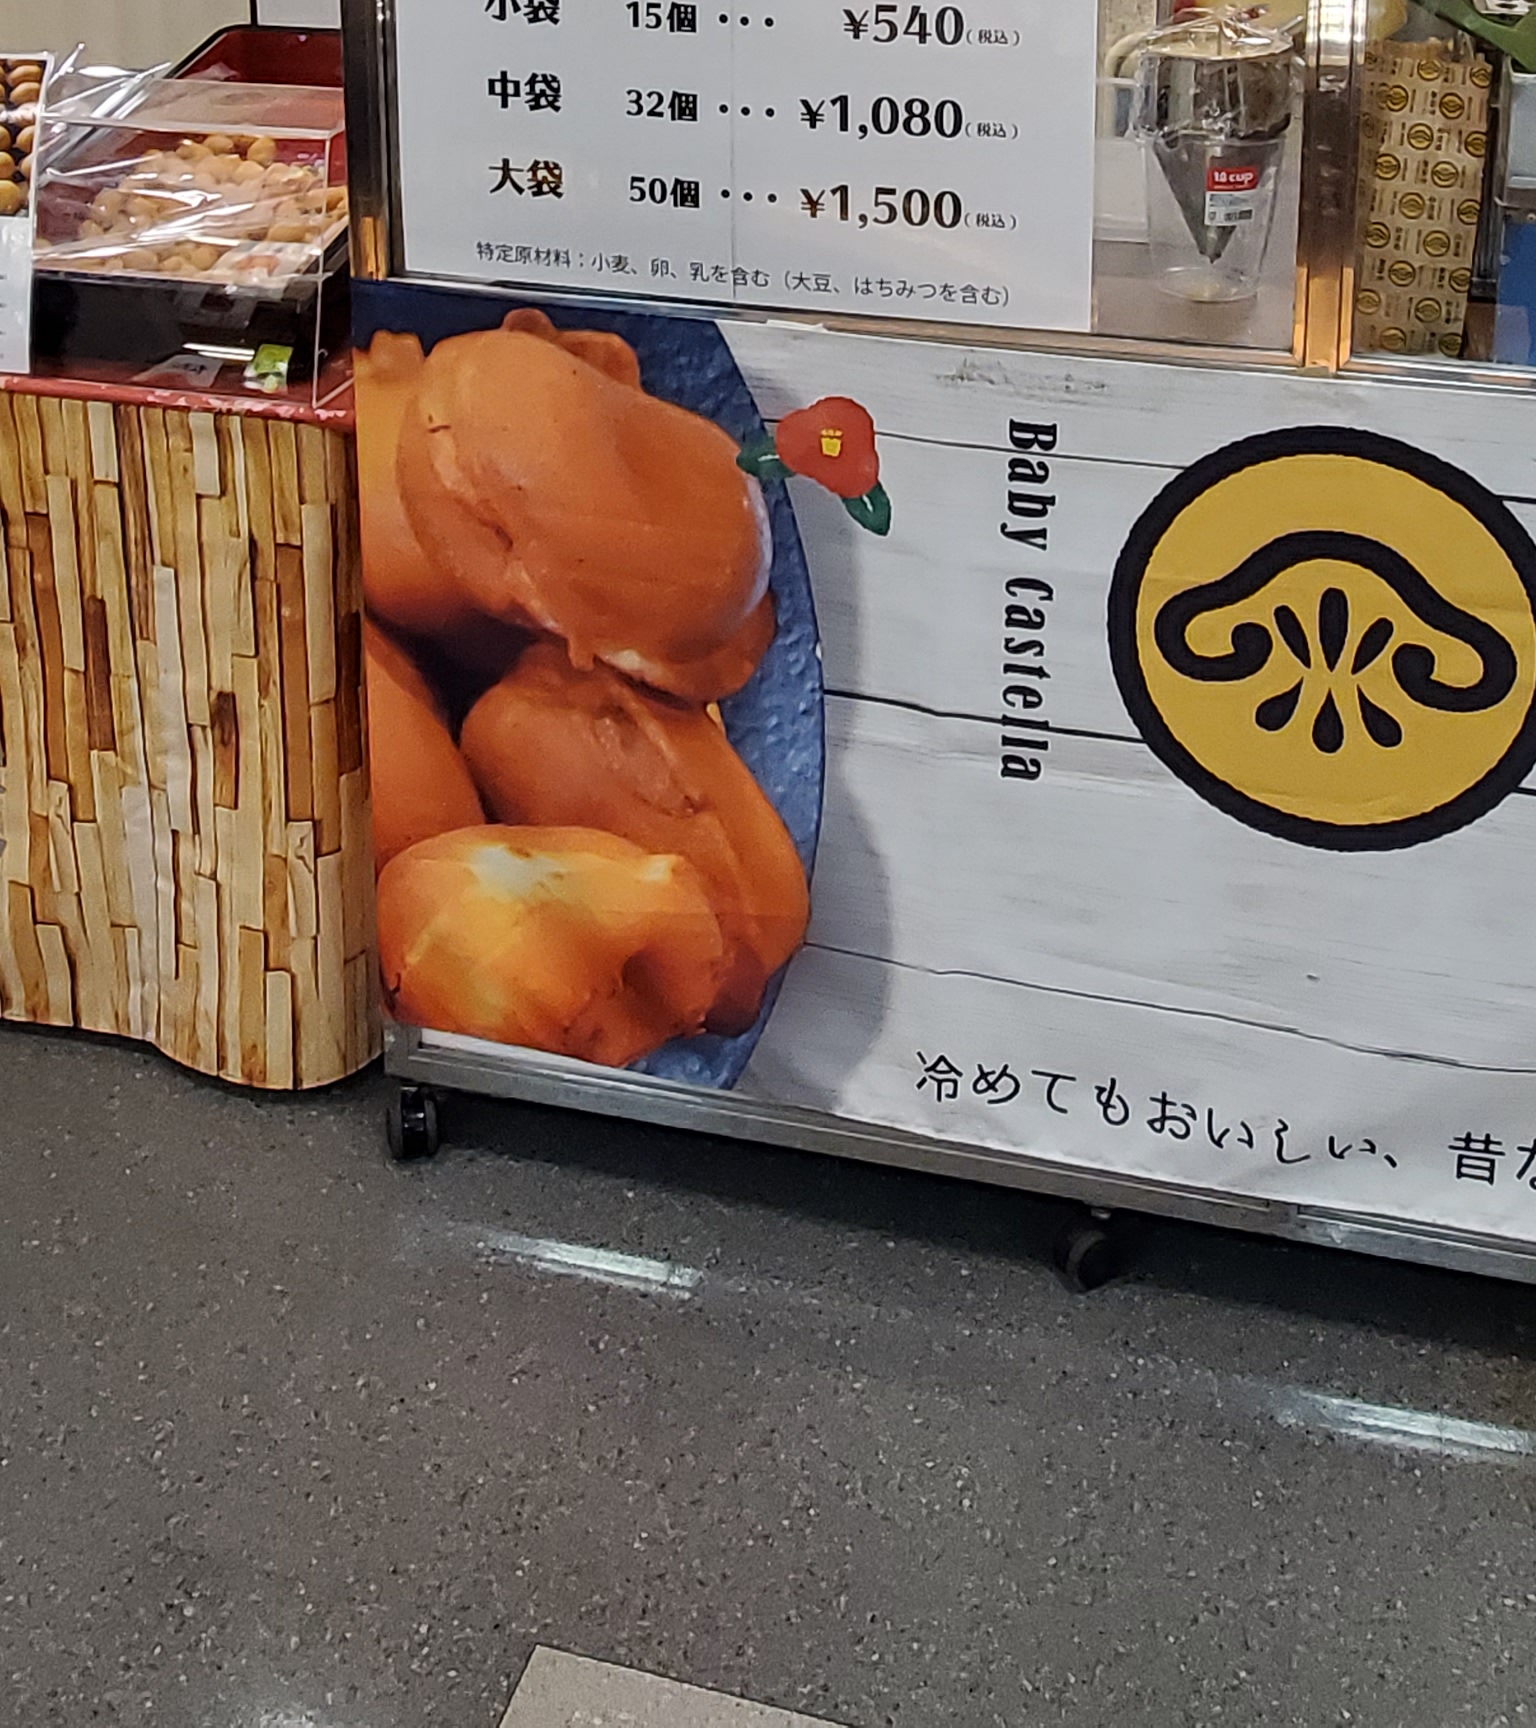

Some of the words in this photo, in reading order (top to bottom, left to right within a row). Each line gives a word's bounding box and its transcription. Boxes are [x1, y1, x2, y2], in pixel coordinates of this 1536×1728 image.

[487, 71, 562, 114] 中袋
[487, 159, 564, 199] 大袋
[1002, 417, 1058, 553] Baby
[1000, 577, 1054, 782] Castella
